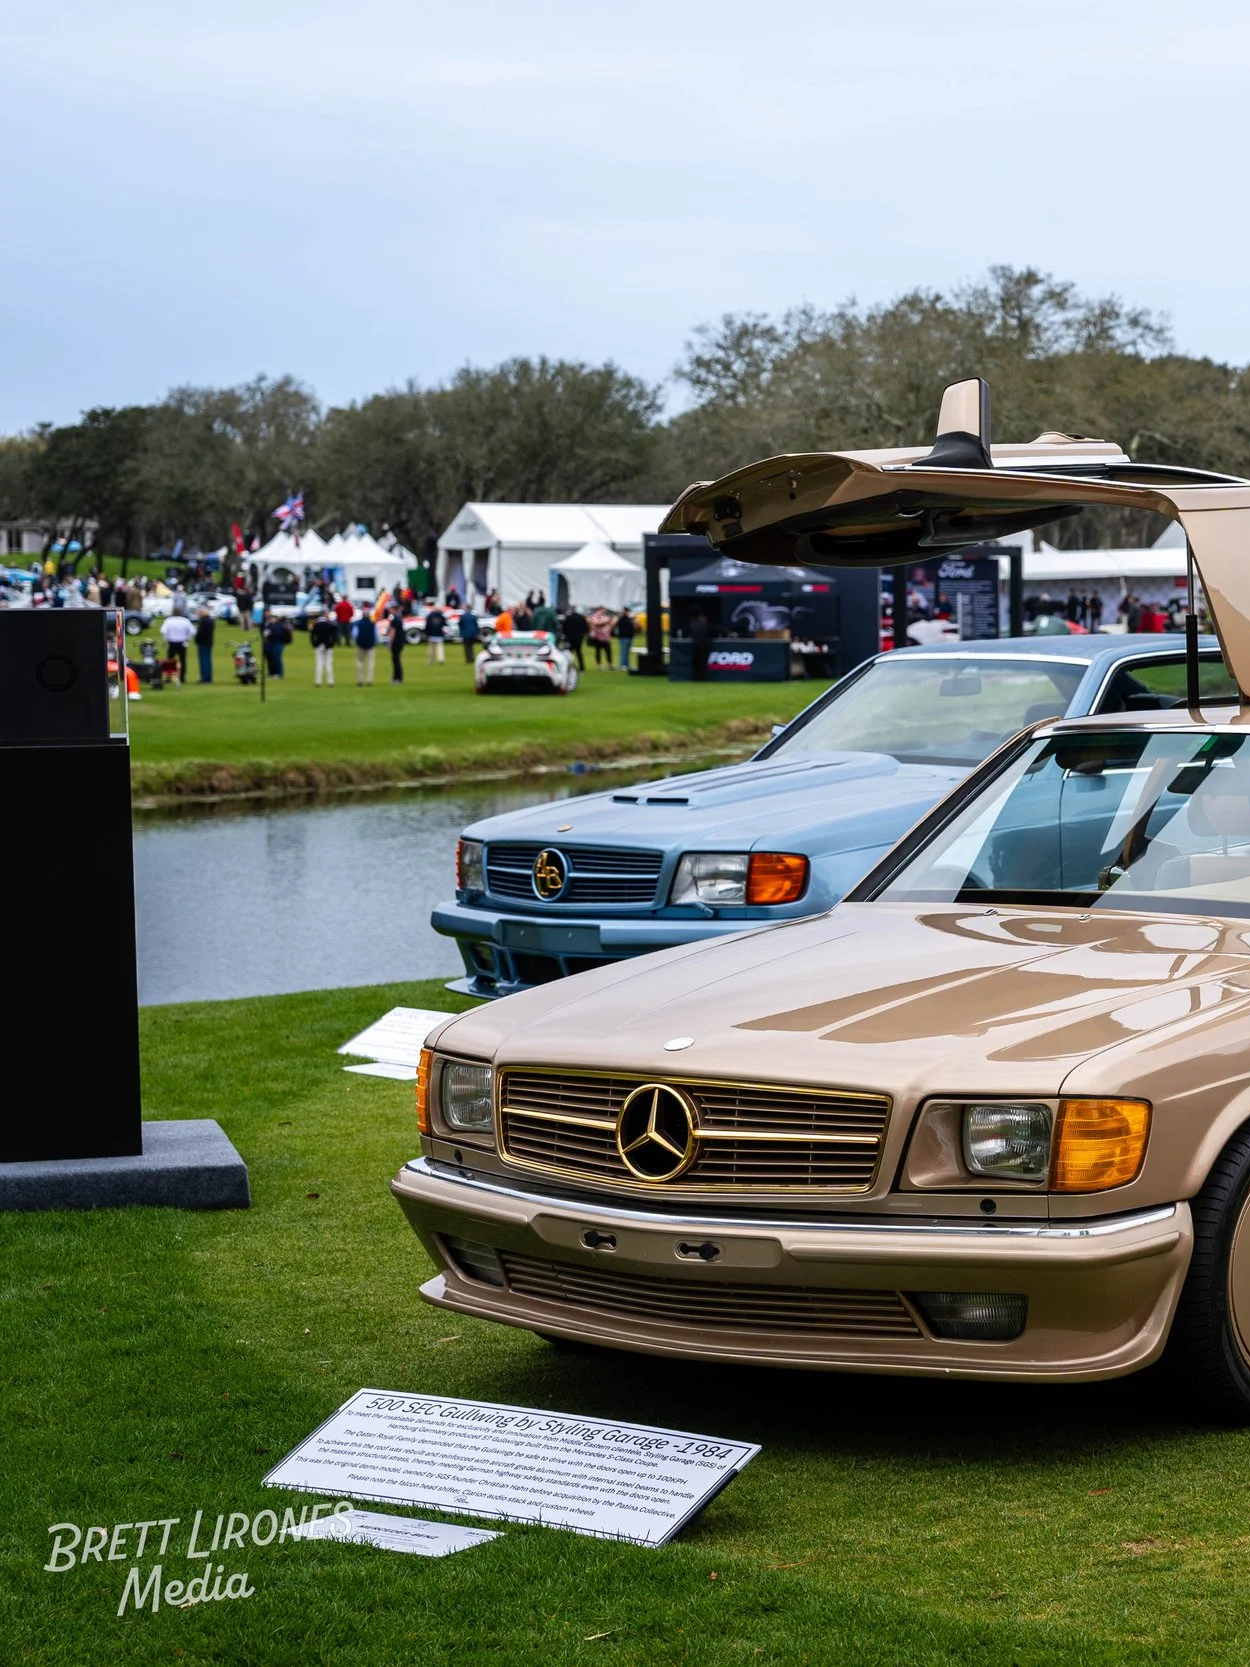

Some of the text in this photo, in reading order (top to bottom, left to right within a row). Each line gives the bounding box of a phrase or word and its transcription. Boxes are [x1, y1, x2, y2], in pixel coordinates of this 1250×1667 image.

[707, 652, 754, 666] FORD
[366, 1398, 405, 1411] 500
[402, 1402, 441, 1415] SEC
[440, 1407, 517, 1428] Gullwing
[514, 1416, 541, 1431] by
[539, 1420, 603, 1440] Styling
[603, 1430, 669, 1450] Garage
[388, 1423, 418, 1432] Hamburg
[419, 1427, 449, 1436] Germany
[492, 1437, 525, 1446] Gullwings
[572, 1449, 606, 1458] Mercedes
[415, 1418, 446, 1426] demands
[457, 1424, 492, 1433] exclusivity
[506, 1431, 541, 1439] innovation
[559, 1438, 583, 1446] Middle
[584, 1442, 610, 1450] Eastern
[644, 1451, 669, 1461] Styling
[669, 1456, 695, 1465] Garage
[418, 1439, 455, 1447] demanded
[481, 1447, 514, 1456] Gullwings
[412, 1458, 438, 1466] thereby
[438, 1463, 466, 1471] meeting
[466, 1466, 494, 1474] German
[494, 1470, 523, 1479] highway
[545, 1479, 581, 1488] standards
[629, 1492, 650, 1500] doors
[439, 1454, 475, 1462] reinforced
[536, 1468, 571, 1477] aluminum
[588, 1476, 617, 1484] internal
[635, 1484, 659, 1492] beams
[669, 1490, 694, 1499] handle
[451, 1475, 478, 1483] founder
[478, 1480, 509, 1488] Christian
[553, 1492, 591, 1502] acquisition
[615, 1502, 638, 1511] Patina
[462, 1489, 486, 1497] Clarion
[543, 1503, 568, 1511] custom
[569, 1508, 595, 1516] wheels
